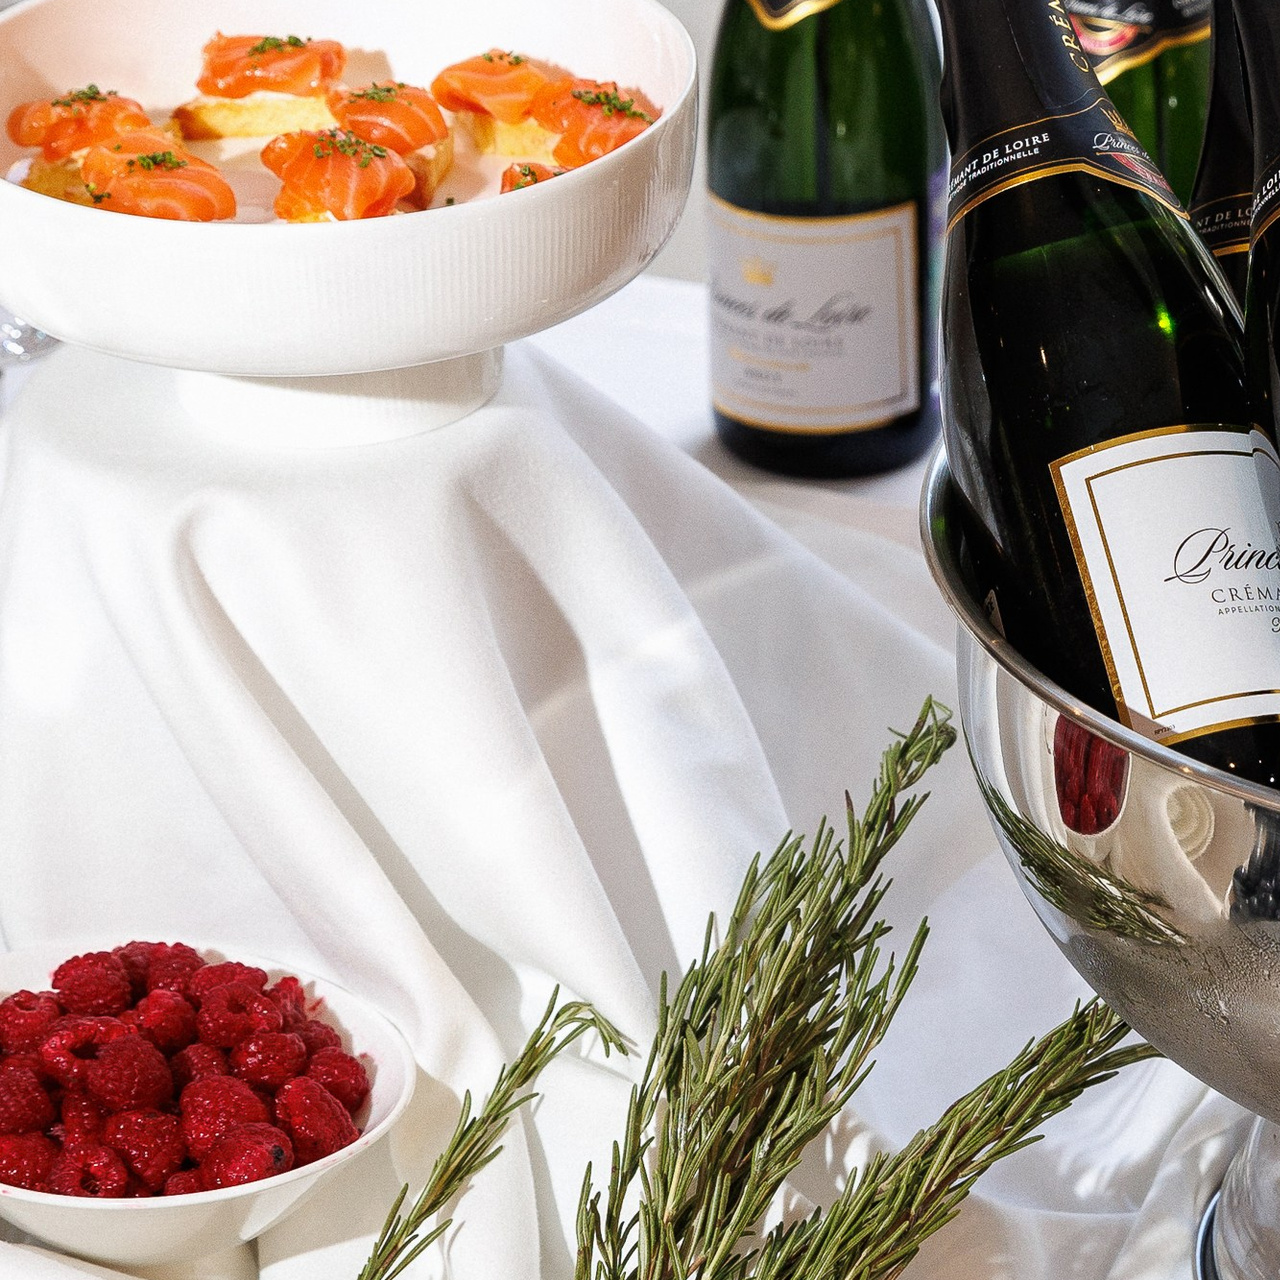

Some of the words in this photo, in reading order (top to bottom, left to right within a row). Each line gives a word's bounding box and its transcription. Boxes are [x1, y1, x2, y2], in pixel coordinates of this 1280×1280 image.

[968, 147, 1040, 181] TRADITIONNELLE
[982, 149, 1000, 164] DE
[1005, 132, 1050, 154] LOIRE
